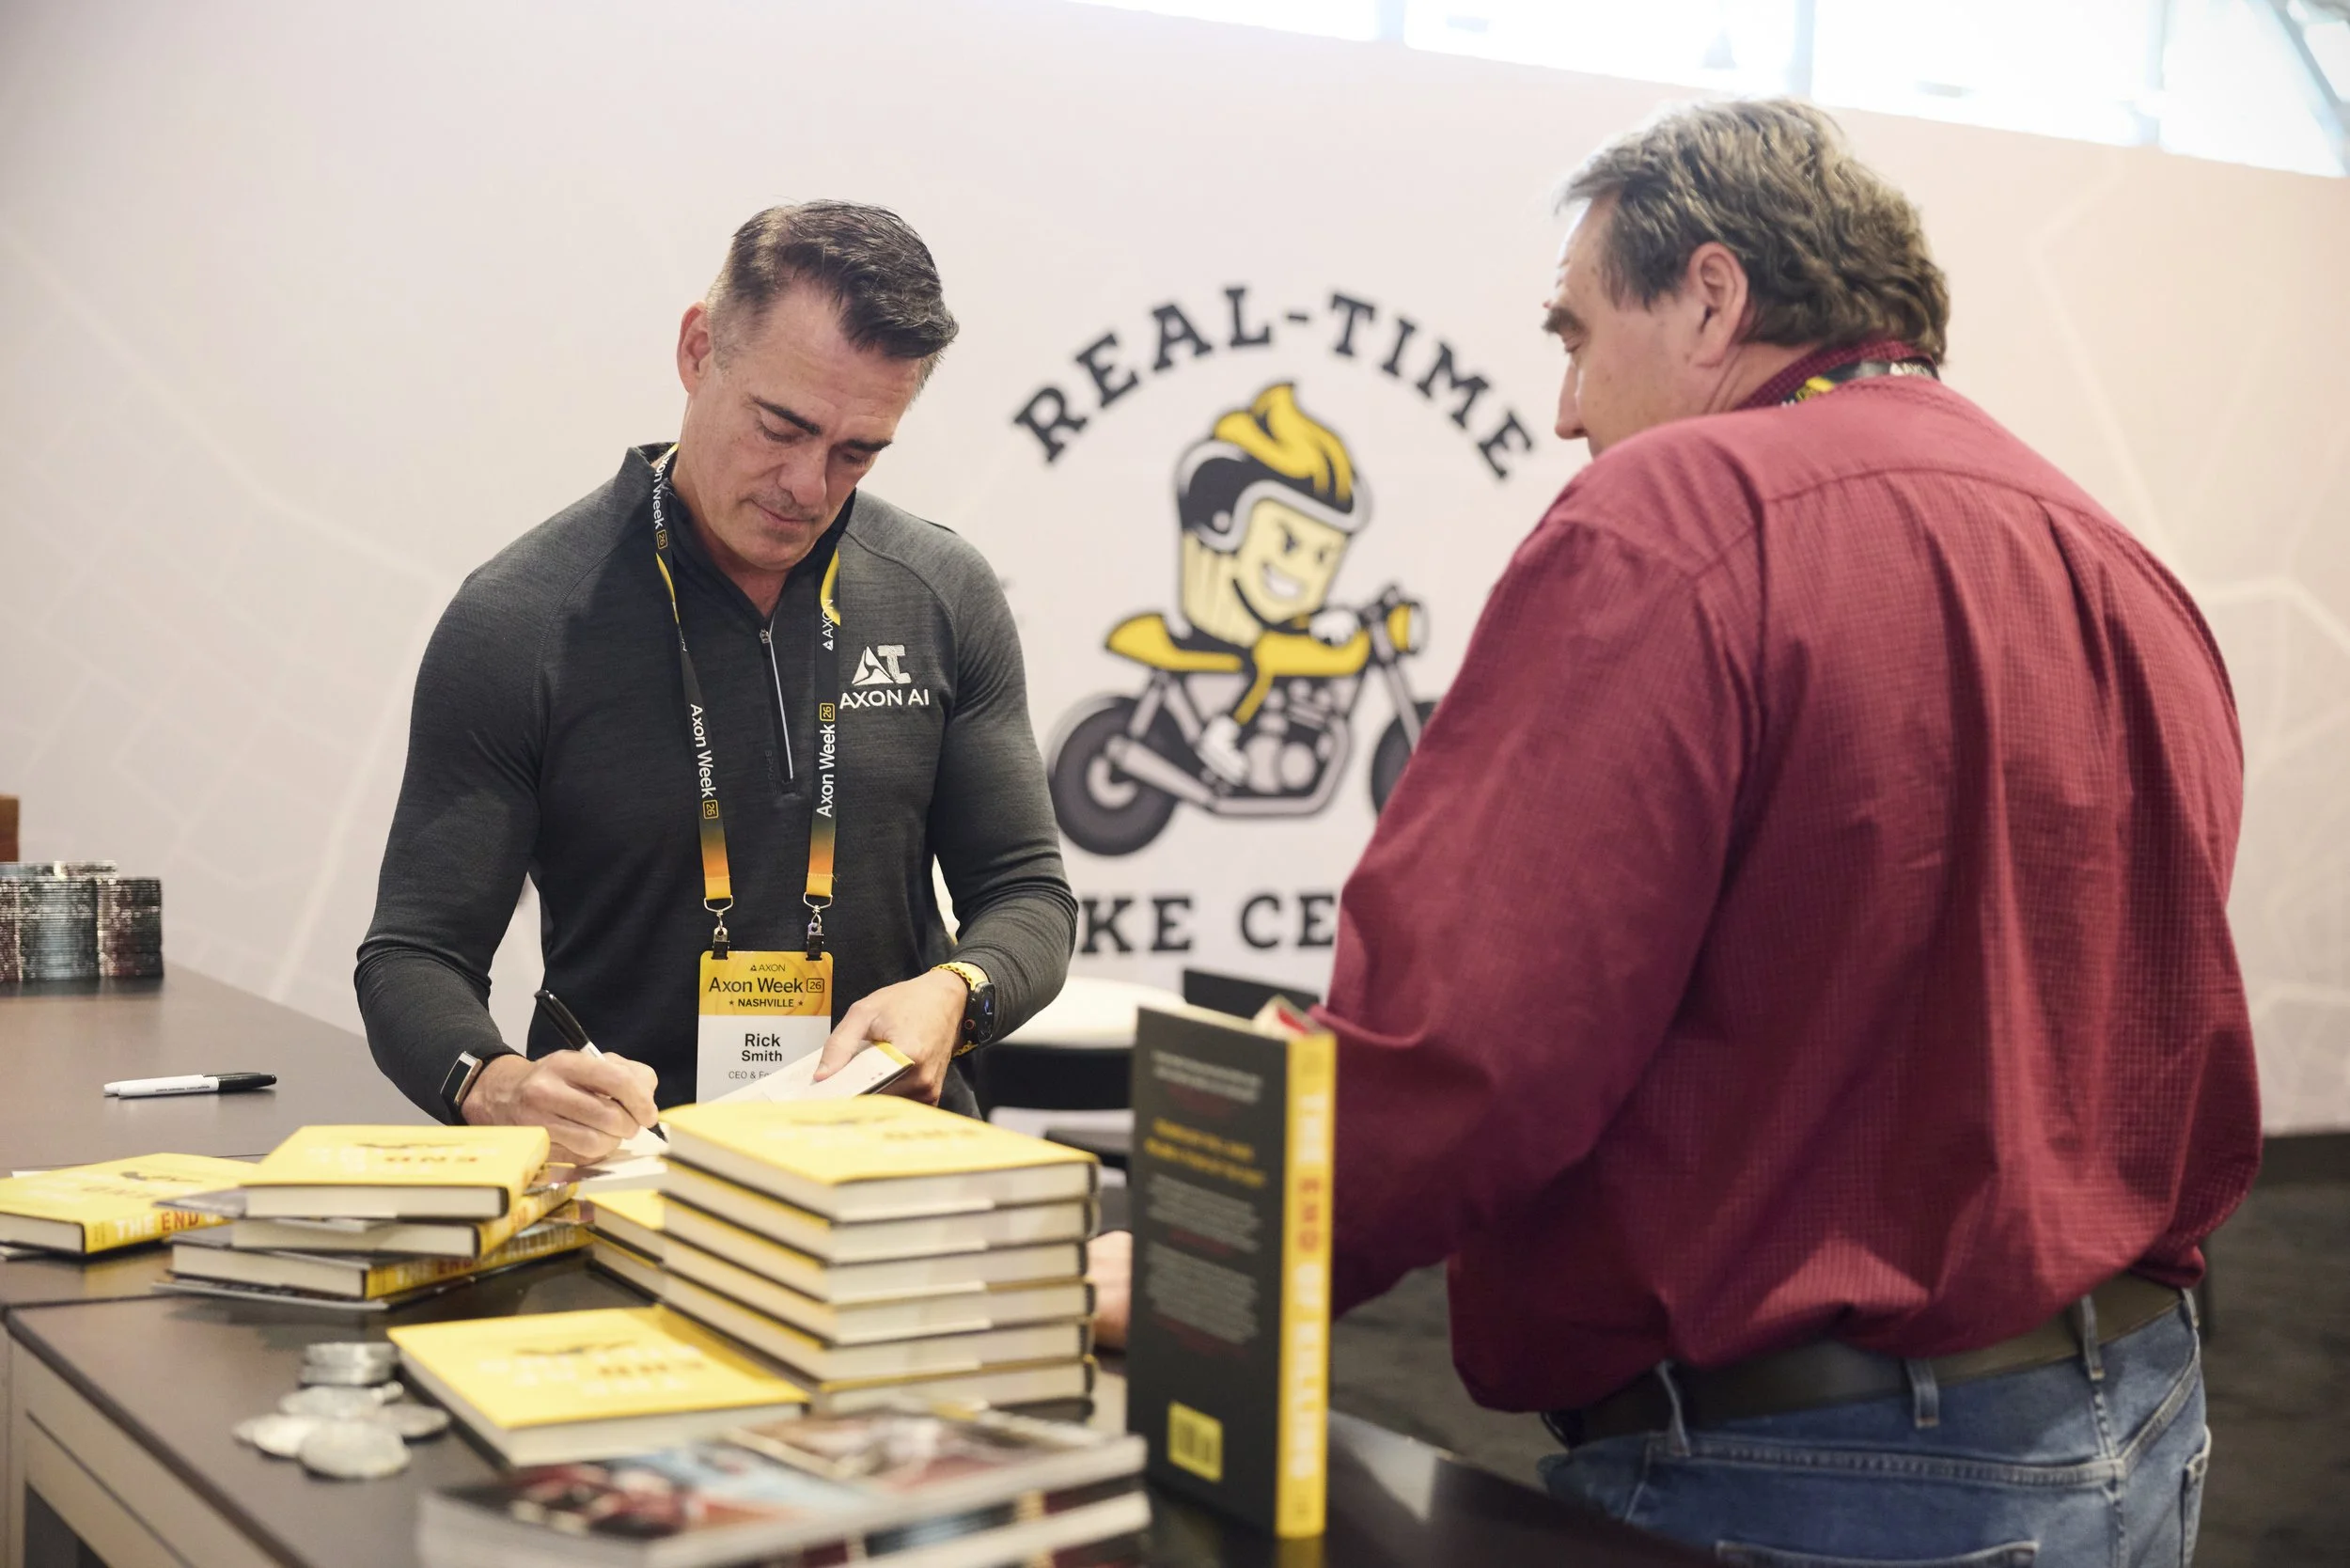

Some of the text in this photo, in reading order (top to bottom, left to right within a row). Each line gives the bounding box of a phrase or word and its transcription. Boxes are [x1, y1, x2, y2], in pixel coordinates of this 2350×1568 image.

[1013, 287, 1533, 481] REAL-TIME
[652, 483, 666, 530] Week
[822, 599, 835, 639] AXON
[839, 688, 930, 710] AXON AI
[690, 703, 707, 747] Axon
[819, 723, 836, 770] Week
[697, 750, 716, 798] Week
[816, 774, 834, 818] Axon
[1079, 894, 1335, 954] KE CE
[709, 977, 753, 993] Axon
[757, 977, 803, 993] Week
[759, 964, 786, 972] AXON
[738, 998, 794, 1008] NASHVILLE
[741, 1049, 783, 1062] Smith
[744, 1033, 781, 1047] Rick
[728, 1071, 747, 1079] CEO
[749, 1071, 757, 1079] &
[116, 1214, 155, 1242] THE
[160, 1209, 199, 1233] END
